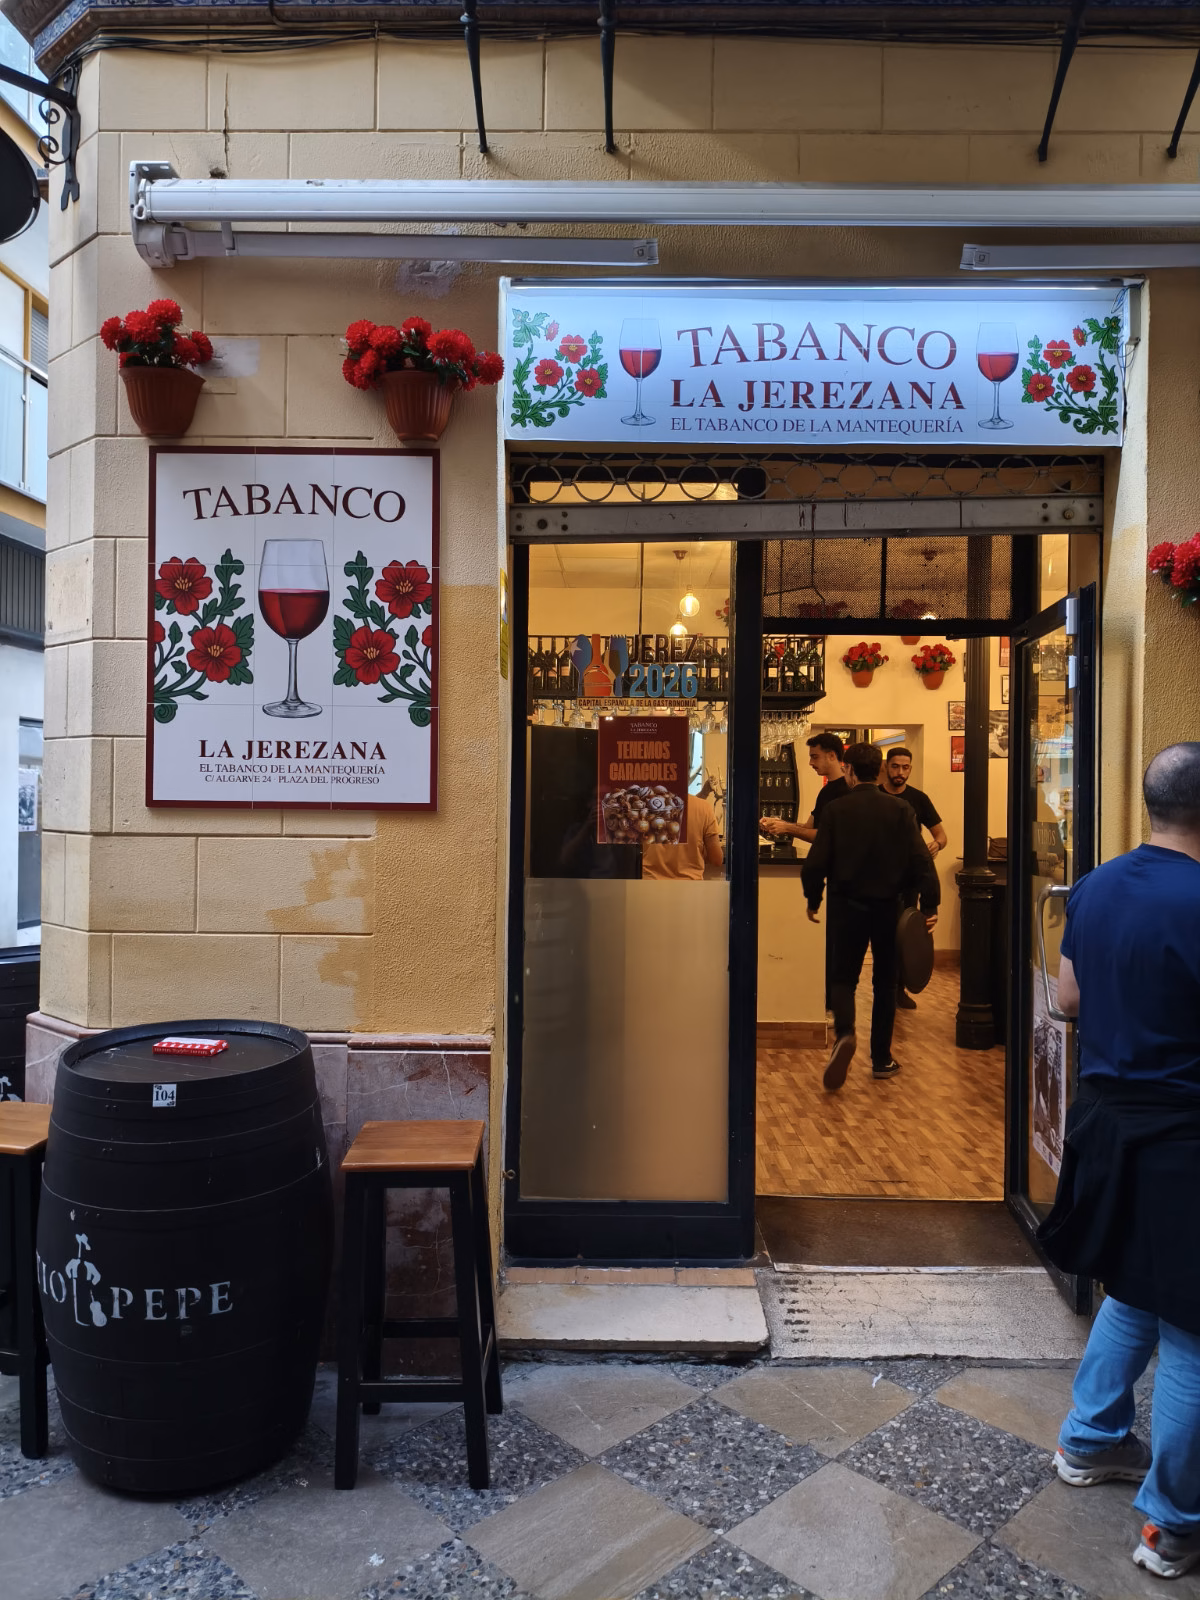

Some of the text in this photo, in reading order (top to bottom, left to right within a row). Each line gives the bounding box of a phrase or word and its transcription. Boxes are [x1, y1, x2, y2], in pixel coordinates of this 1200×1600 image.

[677, 321, 957, 370] TABANCO
[670, 379, 966, 412] LA JEREZANA
[671, 416, 964, 435] EL TABANCO DE LA MANTEQUERÍA
[183, 483, 406, 523] TABANCO
[629, 634, 698, 663] JEREZ
[629, 664, 698, 698] 2026
[578, 698, 603, 707] CAPITAL
[644, 698, 652, 707] LA
[198, 740, 387, 760] LA JEREZANA
[616, 741, 670, 760] TENEMOS
[199, 763, 385, 776] EL TABANCO DE LA MANTEQUERÍA
[609, 763, 678, 782] CARACOLES
[205, 775, 215, 783] C/
[278, 776, 308, 784] PLAZA
[310, 776, 328, 784] DEL
[331, 776, 380, 785] PROGRESO
[154, 1090, 175, 1101] 104
[110, 1281, 234, 1321] PEPE
